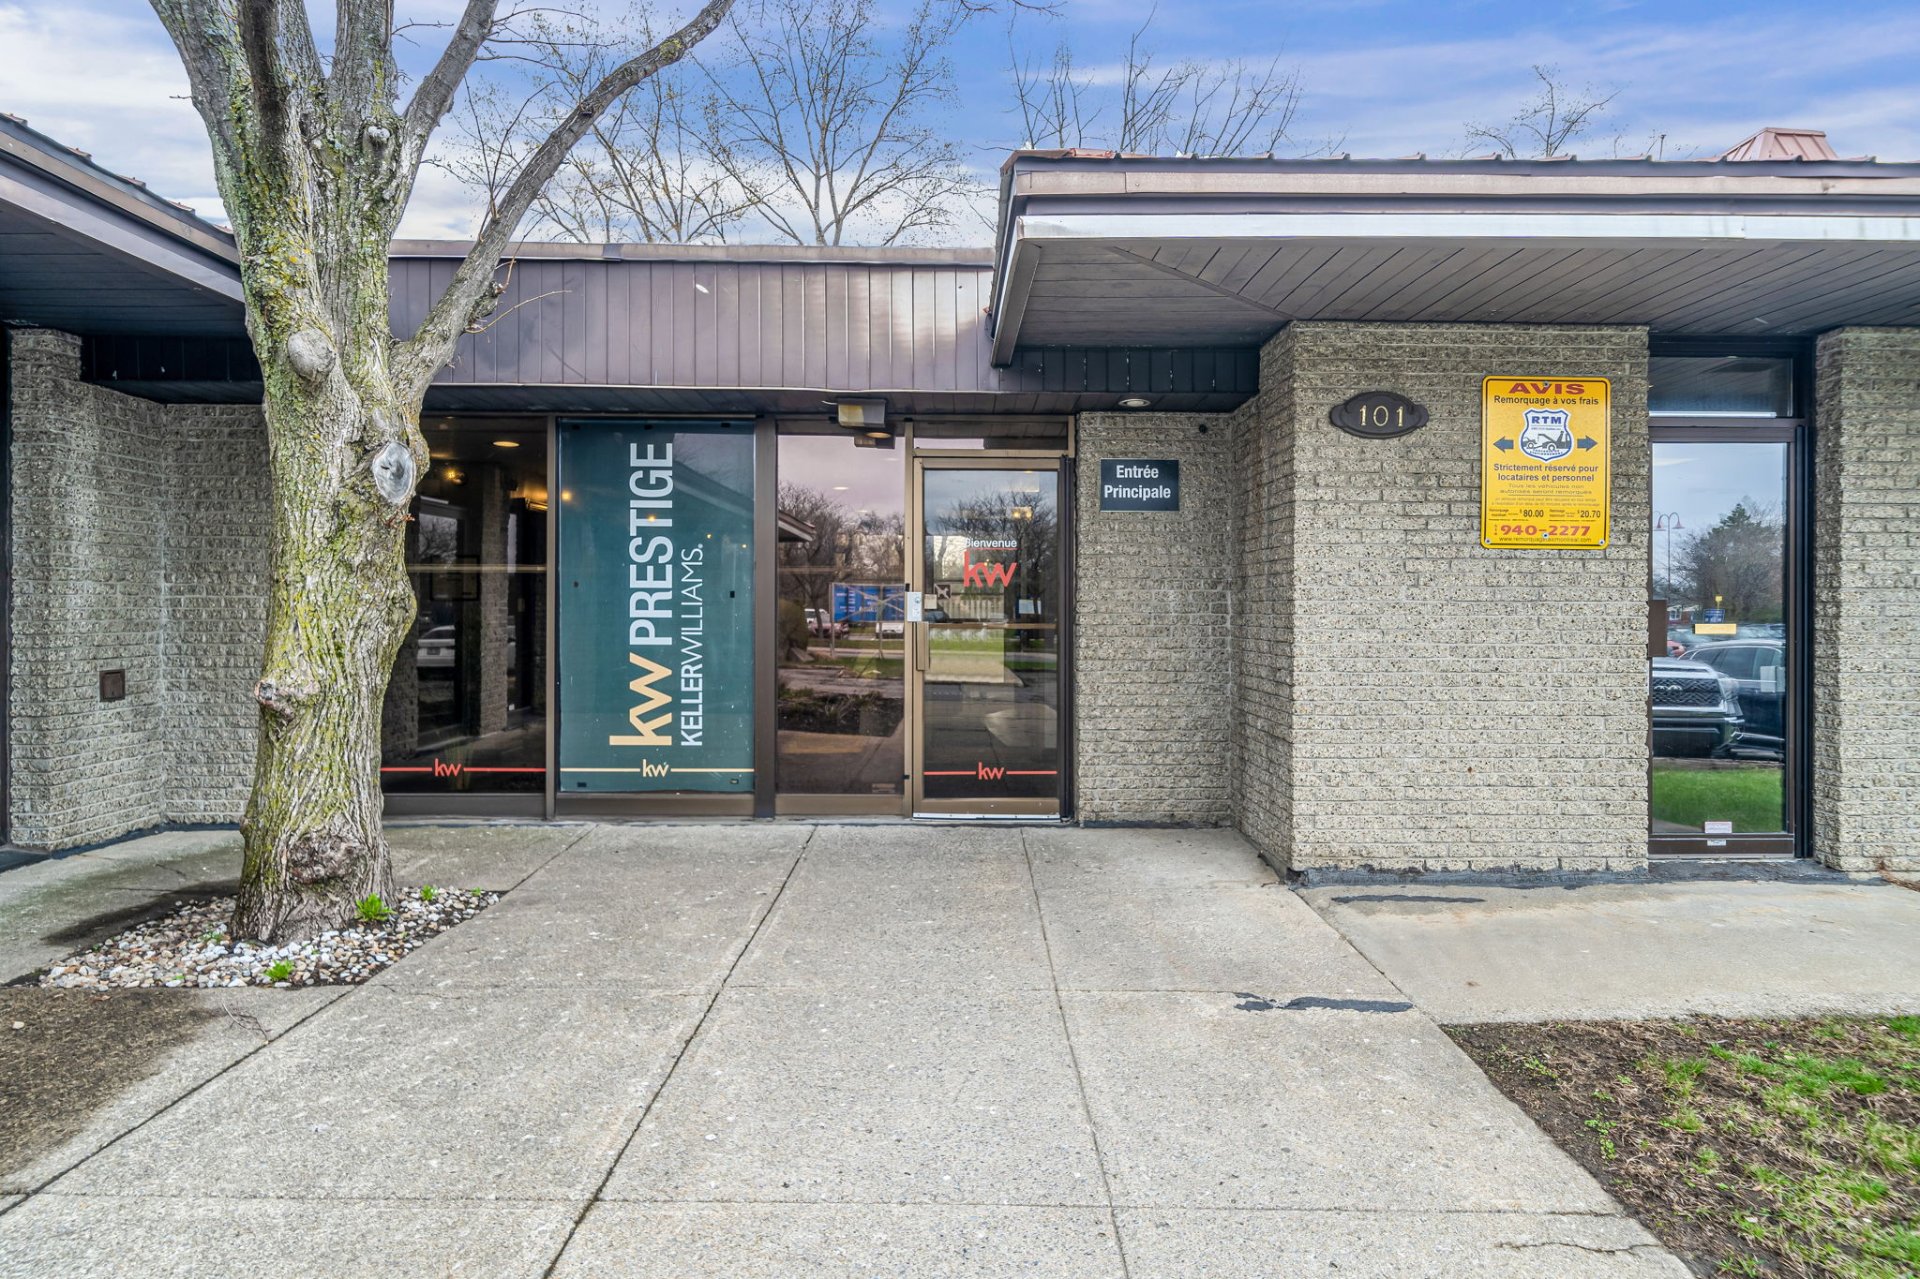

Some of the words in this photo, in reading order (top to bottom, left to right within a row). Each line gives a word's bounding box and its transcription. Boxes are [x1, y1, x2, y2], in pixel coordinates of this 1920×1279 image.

[1509, 382, 1585, 395] AVIS
[1494, 395, 1550, 406] Remorquage
[1553, 395, 1558, 405] à
[1560, 397, 1577, 405] vos
[1579, 396, 1599, 405] frais
[1360, 404, 1404, 427] 101
[1531, 416, 1562, 424] RTM
[1116, 464, 1159, 479] Entrée
[1494, 463, 1542, 472] Strictement
[1544, 463, 1576, 472] réservé
[1578, 465, 1598, 474] pour
[1498, 473, 1539, 481] locataires
[1552, 474, 1595, 483] personnel
[1104, 484, 1171, 501] Principale
[1500, 525, 1591, 536] 940-2277
[629, 442, 673, 646] PRESTIGE
[965, 538, 1017, 548] Bienvenue
[963, 551, 1018, 588] kw
[435, 758, 462, 777] kw
[643, 759, 669, 777] kw
[978, 761, 1005, 780] kw
